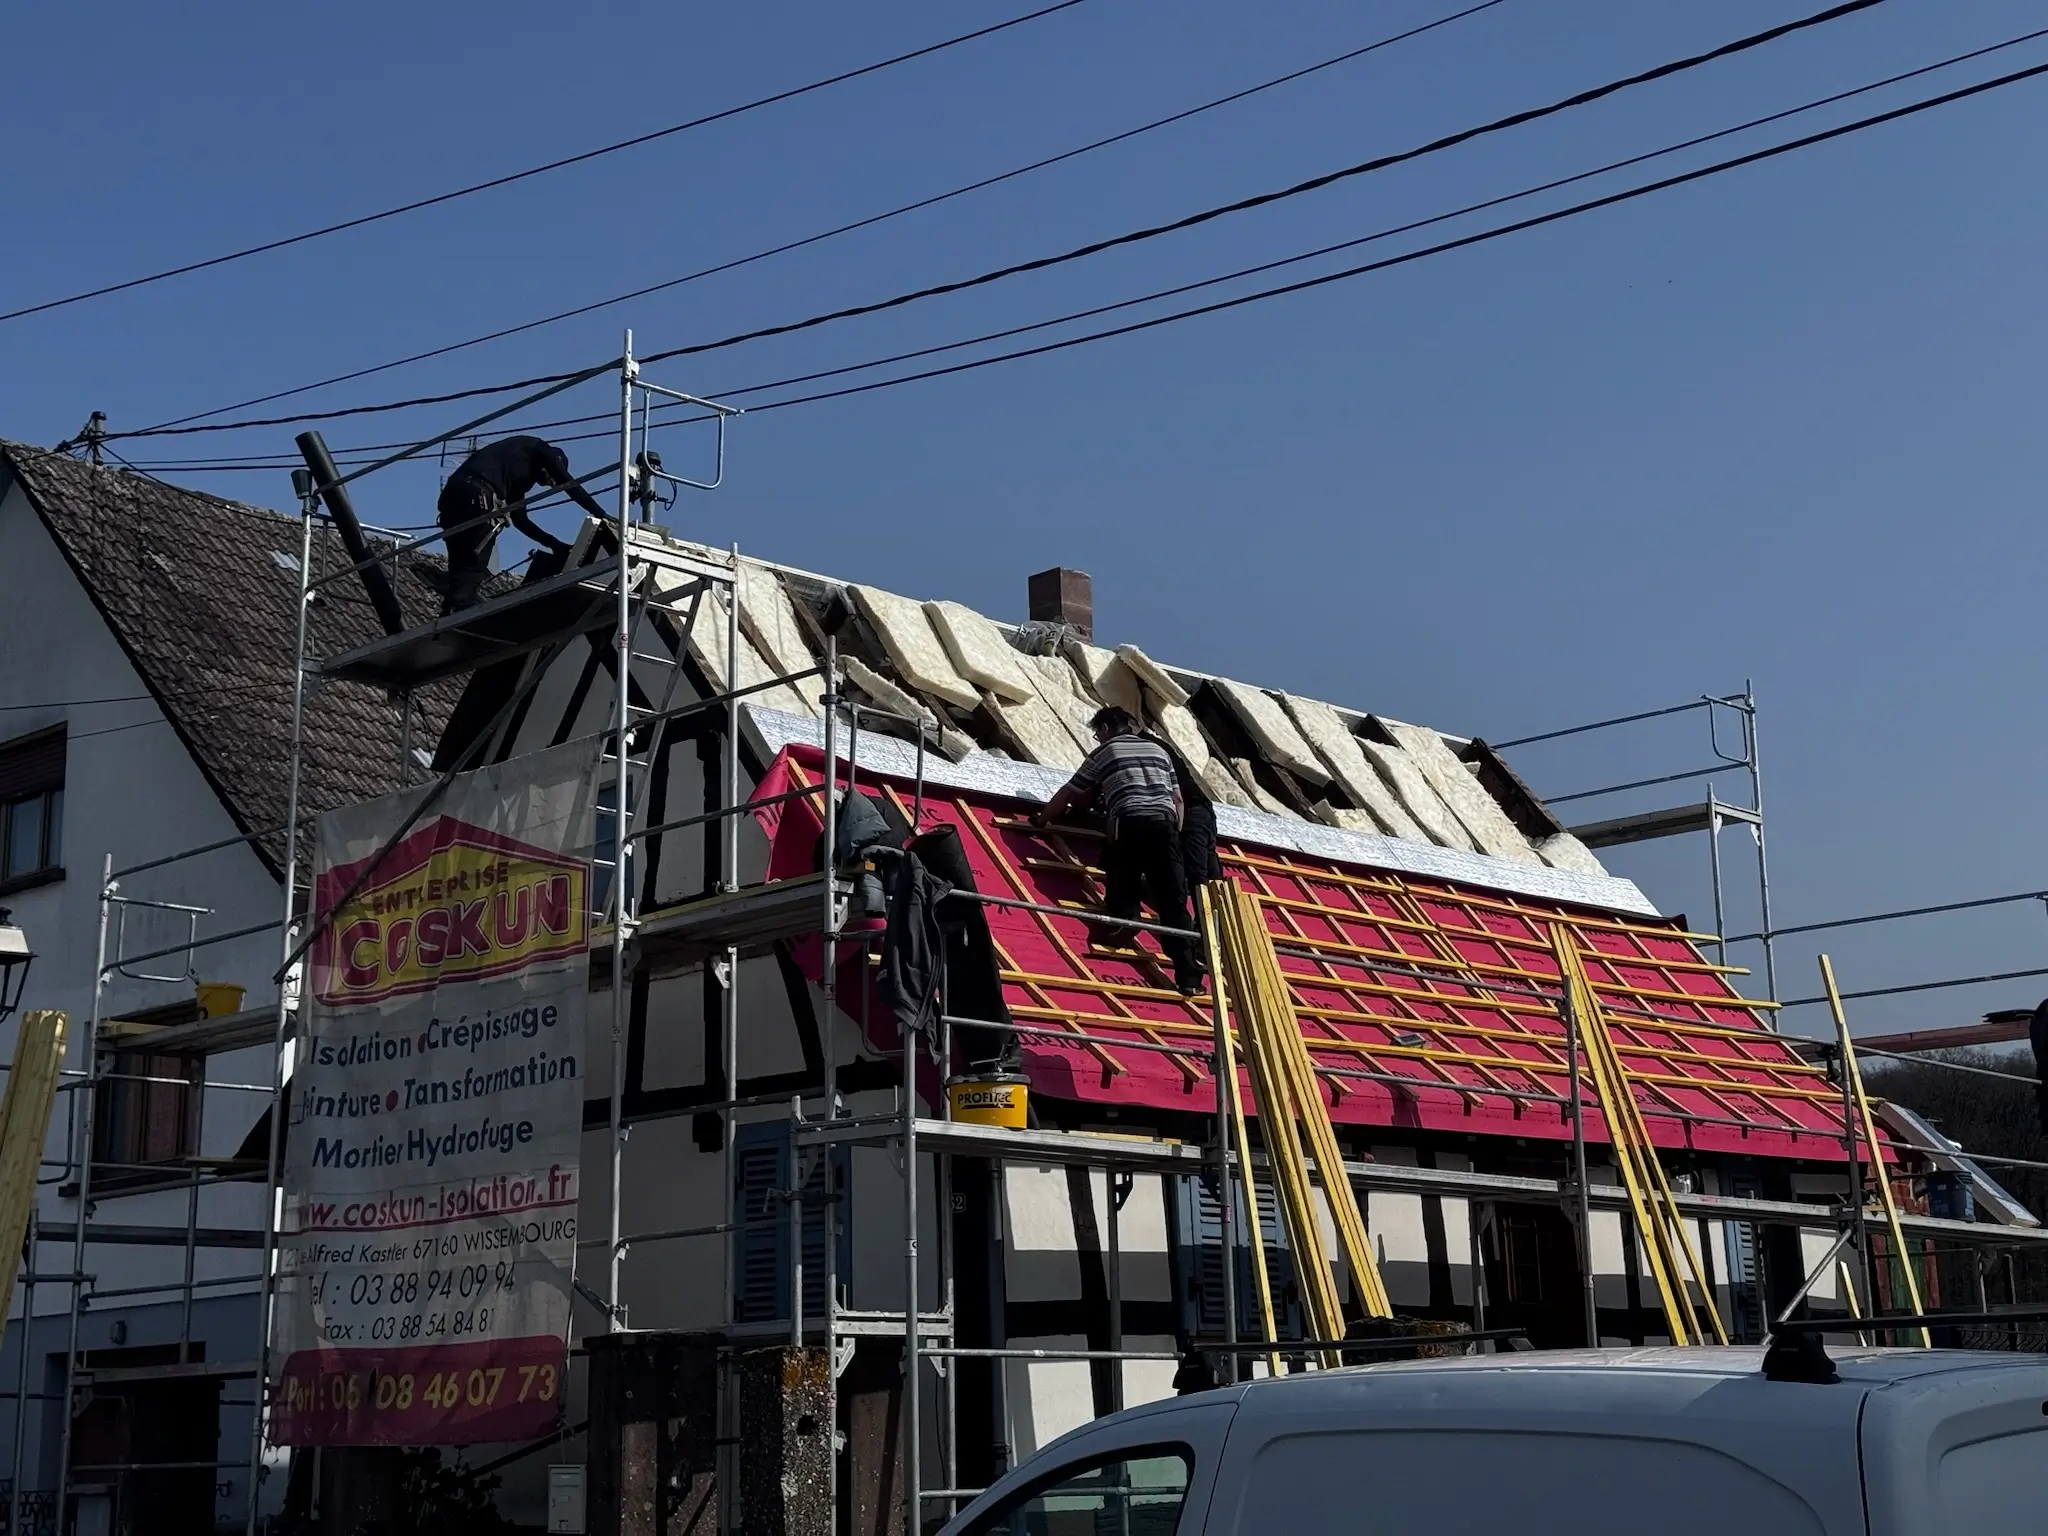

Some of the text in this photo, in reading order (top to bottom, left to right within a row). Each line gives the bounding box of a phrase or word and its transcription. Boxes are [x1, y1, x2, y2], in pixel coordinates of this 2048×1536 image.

[339, 874, 572, 989] COSKUN
[310, 1004, 558, 1067] Isolation Crépissage
[312, 1118, 533, 1168] Mortier Hydrofuge
[359, 1239, 407, 1262] Kastler
[413, 1235, 458, 1260] 67160
[464, 1218, 576, 1251] WISSEMBOURG
[351, 1274, 383, 1305] 03
[390, 1272, 419, 1304] 88
[428, 1269, 453, 1301] 94
[460, 1264, 487, 1297] 09
[495, 1260, 515, 1293] 94
[324, 1317, 354, 1340] Fax
[372, 1316, 395, 1340] 03
[400, 1314, 422, 1339] 88
[425, 1313, 446, 1337] 54
[453, 1310, 474, 1335] 84
[375, 1373, 416, 1410] 08
[423, 1371, 459, 1410] 46
[467, 1366, 507, 1406] 07
[518, 1364, 557, 1404] 73
